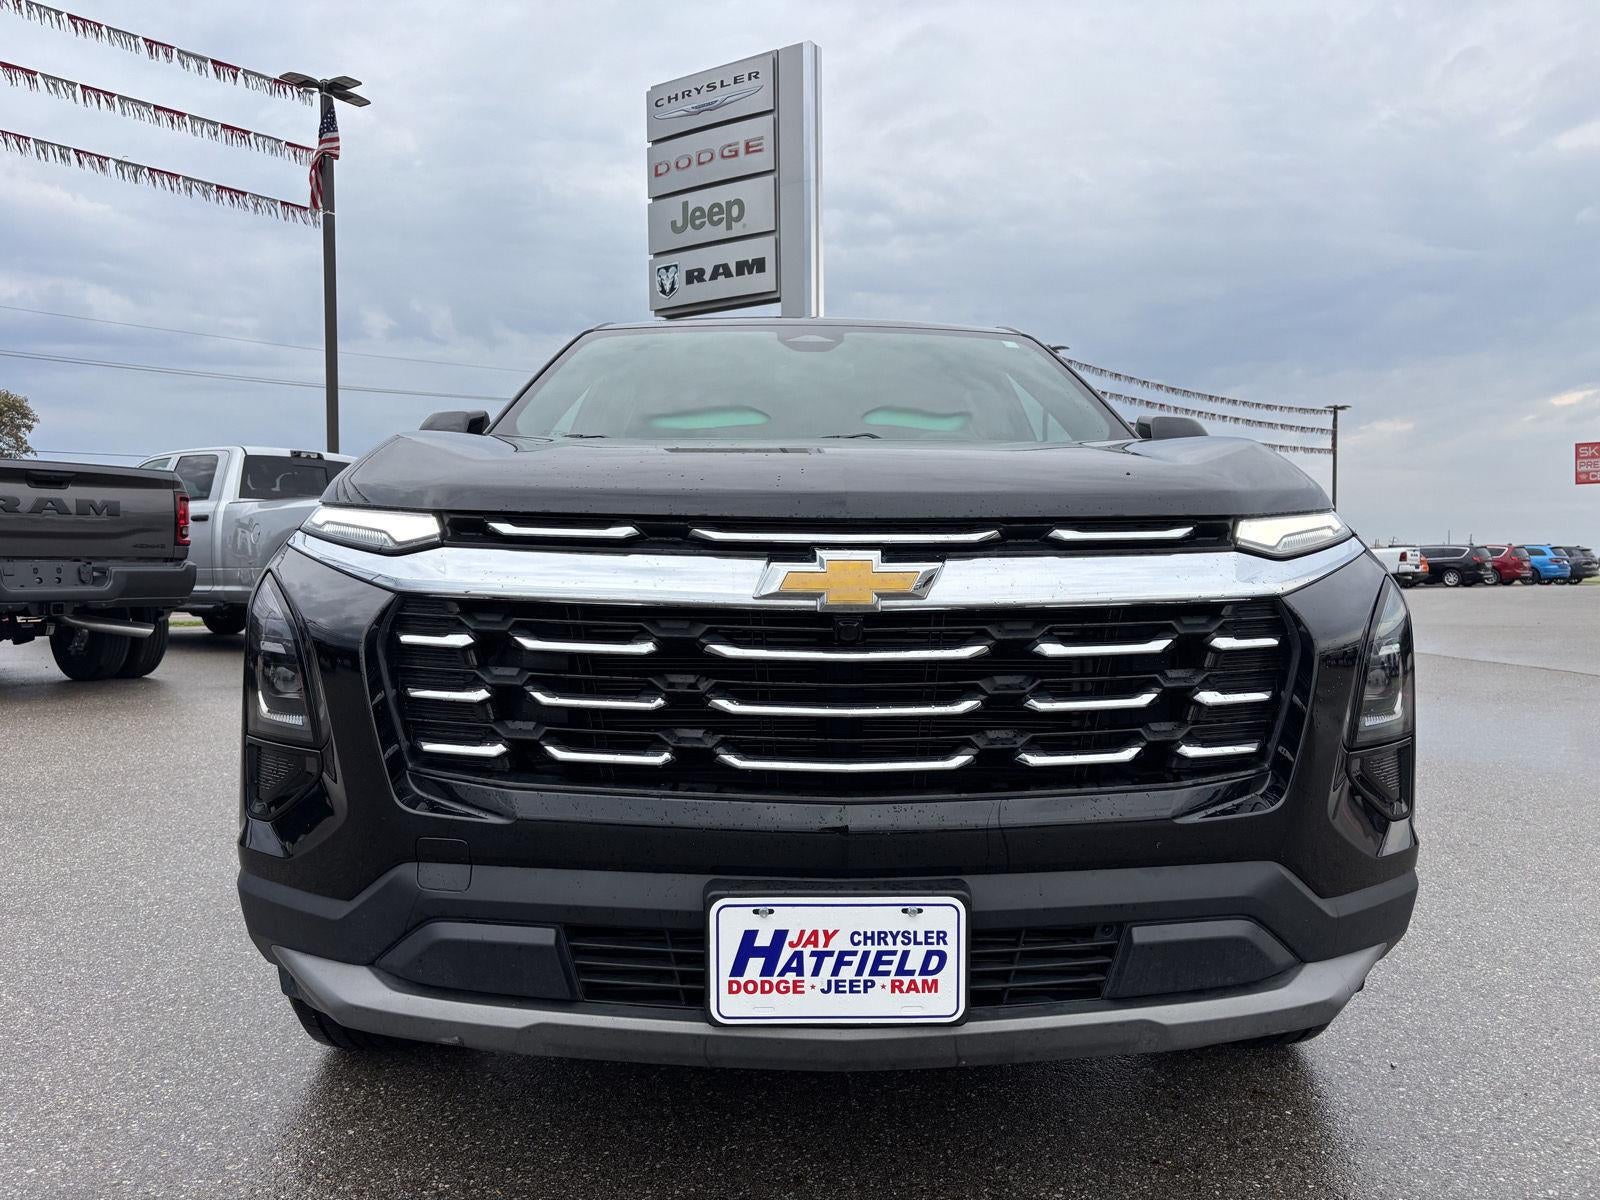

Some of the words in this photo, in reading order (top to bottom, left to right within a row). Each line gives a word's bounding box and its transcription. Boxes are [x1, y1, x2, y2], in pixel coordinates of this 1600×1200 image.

[654, 70, 761, 108] CHRYSLER
[654, 136, 764, 178] DODGE
[670, 197, 745, 235] Jeep
[685, 256, 766, 286] RAM
[1578, 446, 1600, 457] SK
[728, 929, 948, 978] HATFIELD
[788, 929, 840, 949] JAY
[850, 930, 948, 946] CHRYSLER
[727, 979, 806, 995] DODGE
[820, 978, 876, 994] JEEP
[890, 978, 938, 994] RAM
